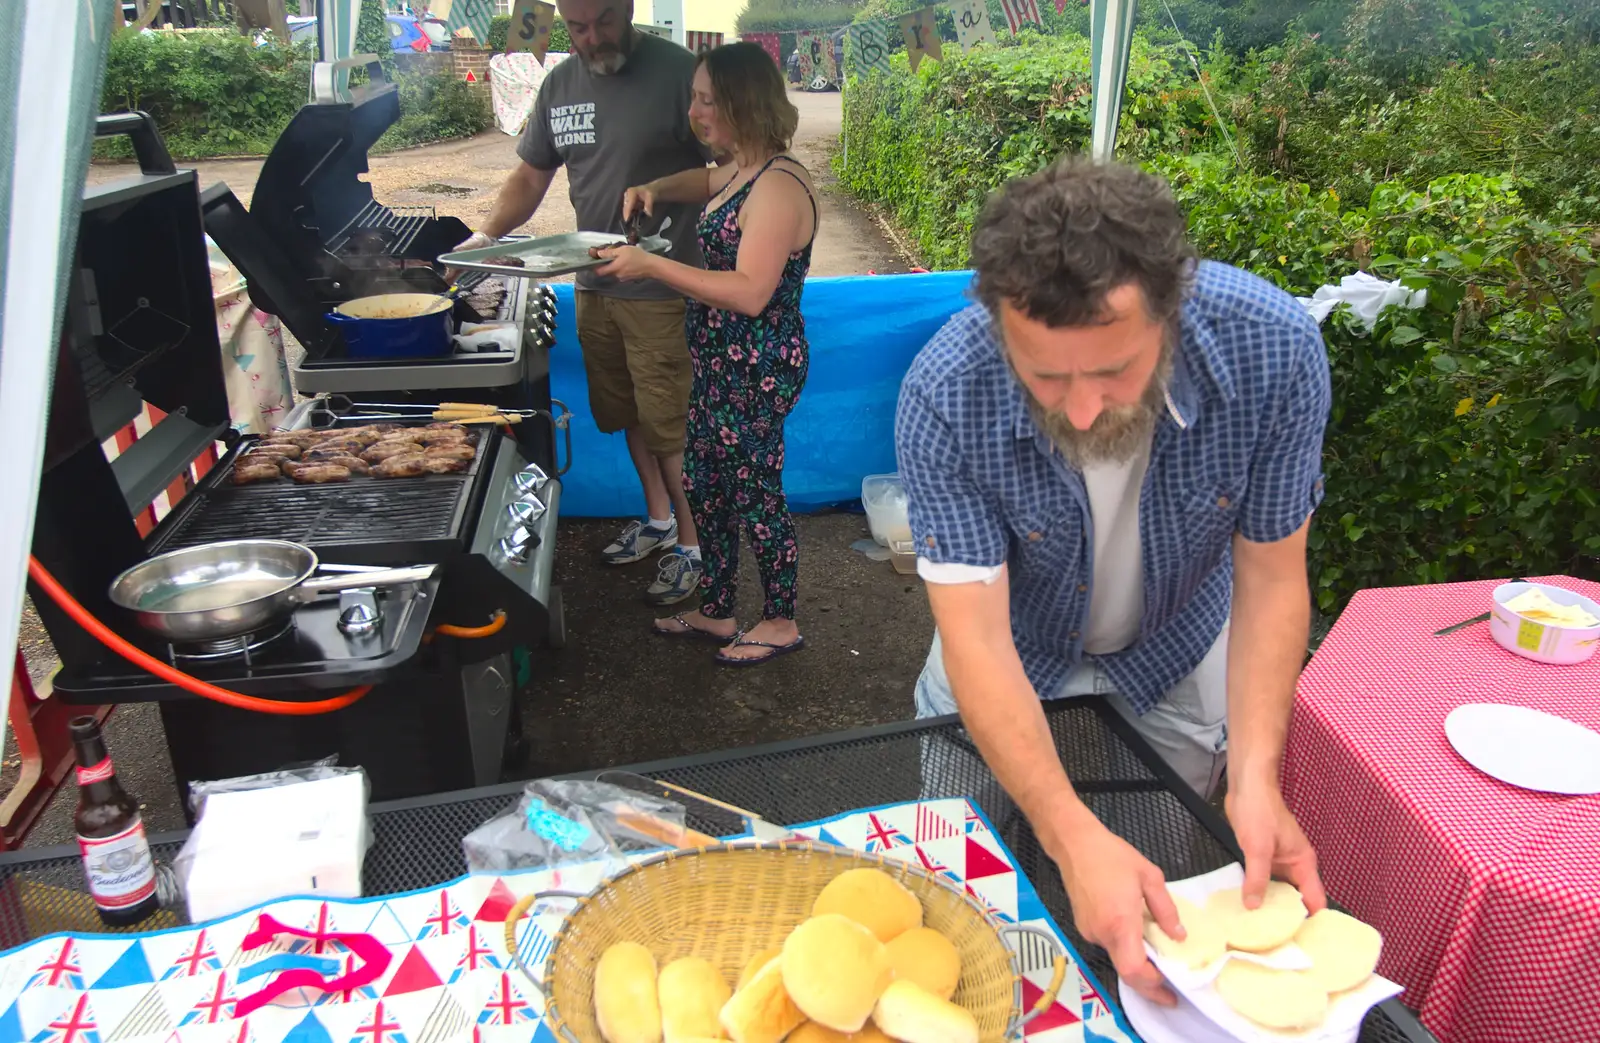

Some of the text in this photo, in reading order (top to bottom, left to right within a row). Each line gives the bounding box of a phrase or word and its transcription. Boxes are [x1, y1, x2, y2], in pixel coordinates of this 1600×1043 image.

[551, 103, 595, 118] NEVER
[550, 113, 595, 134] WALK
[554, 131, 595, 148] ALONE
